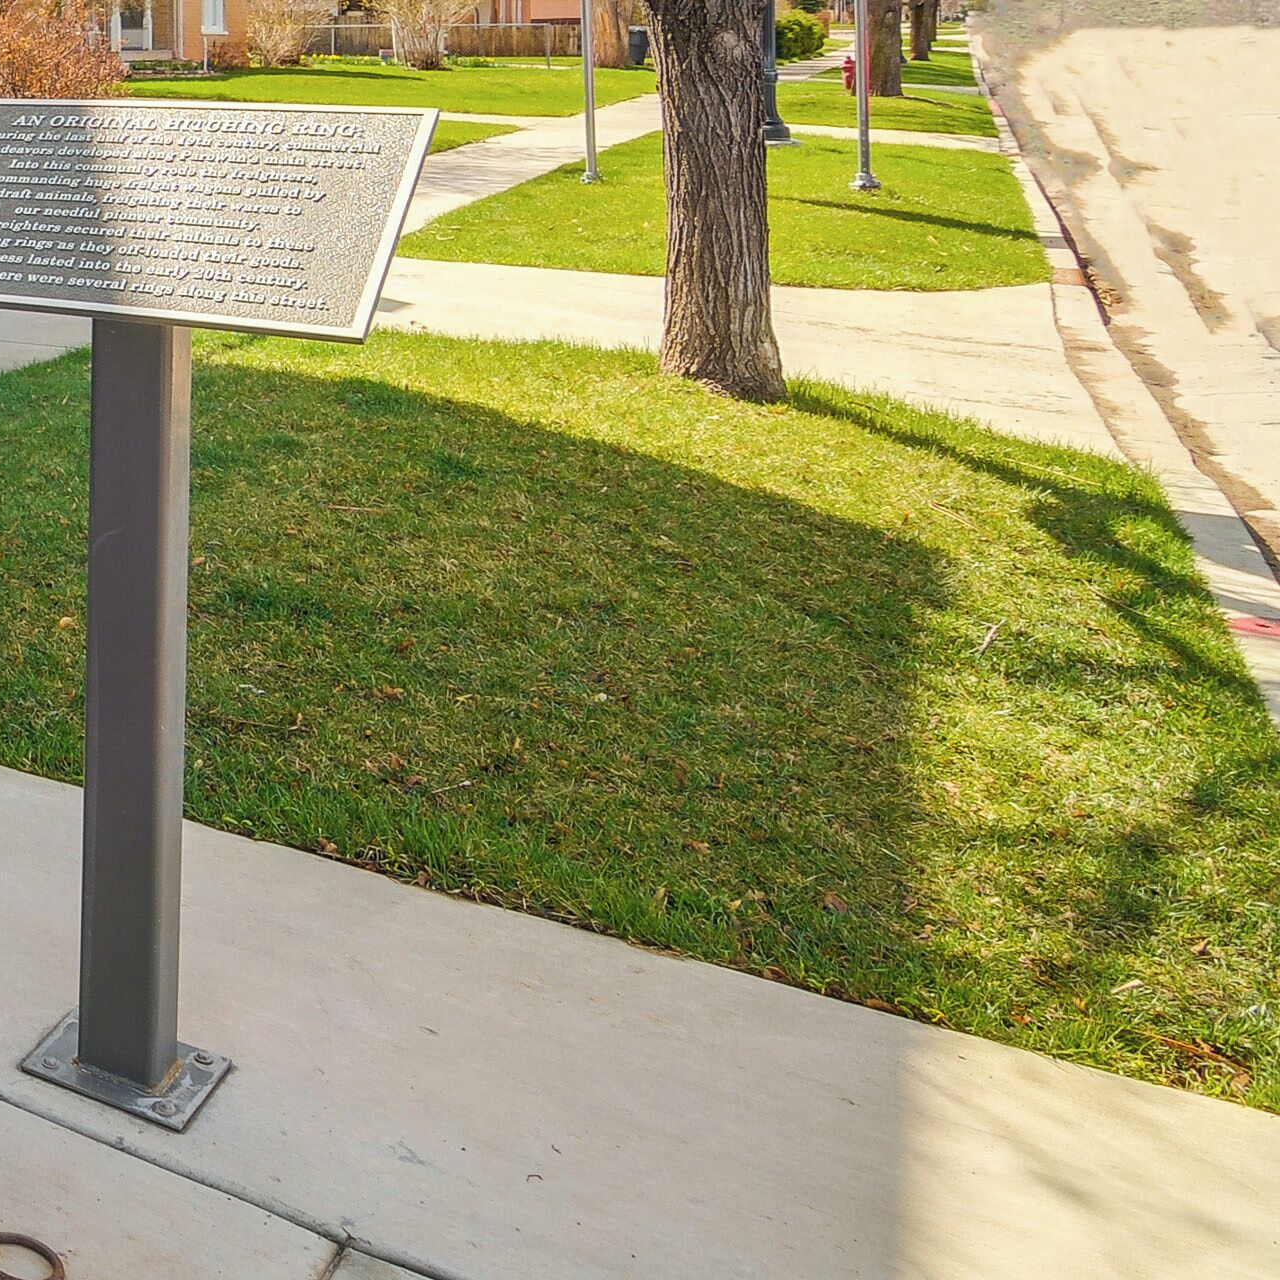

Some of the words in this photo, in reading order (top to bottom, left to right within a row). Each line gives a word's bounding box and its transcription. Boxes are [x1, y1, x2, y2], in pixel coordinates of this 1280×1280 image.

[11, 115, 48, 127] AN
[49, 115, 158, 131] ORIGINAL
[163, 119, 287, 135] HITCHING
[291, 122, 365, 138] RING:
[39, 130, 61, 141] the
[64, 131, 92, 142] last
[96, 132, 128, 144] half
[129, 133, 148, 146] of
[149, 135, 174, 146] the
[178, 136, 213, 147] 19th
[217, 138, 280, 152] century,
[285, 141, 382, 155] commercial
[57, 146, 130, 160] developed
[132, 150, 177, 163] along
[264, 156, 306, 167] main
[310, 158, 366, 169] street.
[8, 159, 39, 169] Into
[42, 159, 71, 170] this
[74, 161, 160, 178] community
[162, 166, 197, 177] rode
[200, 167, 227, 178] the
[231, 170, 318, 184] freighters,
[84, 177, 121, 189] huge
[124, 179, 179, 193] freight
[184, 183, 242, 196] wagons
[245, 186, 300, 199] pulled
[303, 189, 327, 202] by
[35, 190, 97, 206] animals,
[102, 194, 182, 210] freighting
[186, 199, 227, 210] their
[230, 203, 280, 214] wares
[284, 205, 303, 216] to
[14, 206, 42, 215] our
[42, 207, 101, 219] needful
[102, 210, 166, 224] pioneer
[167, 214, 261, 232] community.
[64, 224, 125, 237] secured
[129, 229, 171, 241] their
[173, 232, 240, 246] animals
[245, 236, 262, 247] to
[267, 239, 315, 252] these
[14, 238, 54, 250] rings
[57, 241, 76, 251] as
[79, 242, 115, 255] they
[118, 244, 200, 261] off-loaded
[204, 252, 247, 265] their
[250, 257, 305, 270] goods.
[26, 255, 75, 268] lasted
[78, 260, 111, 271] into
[114, 262, 141, 274] the
[147, 265, 190, 279] early
[192, 268, 232, 282] 20th
[237, 274, 309, 291] century.
[27, 273, 64, 285] were
[67, 275, 127, 291] several
[129, 282, 174, 297] rings
[178, 286, 227, 302] along
[230, 290, 266, 304] this
[270, 294, 330, 312] street.
